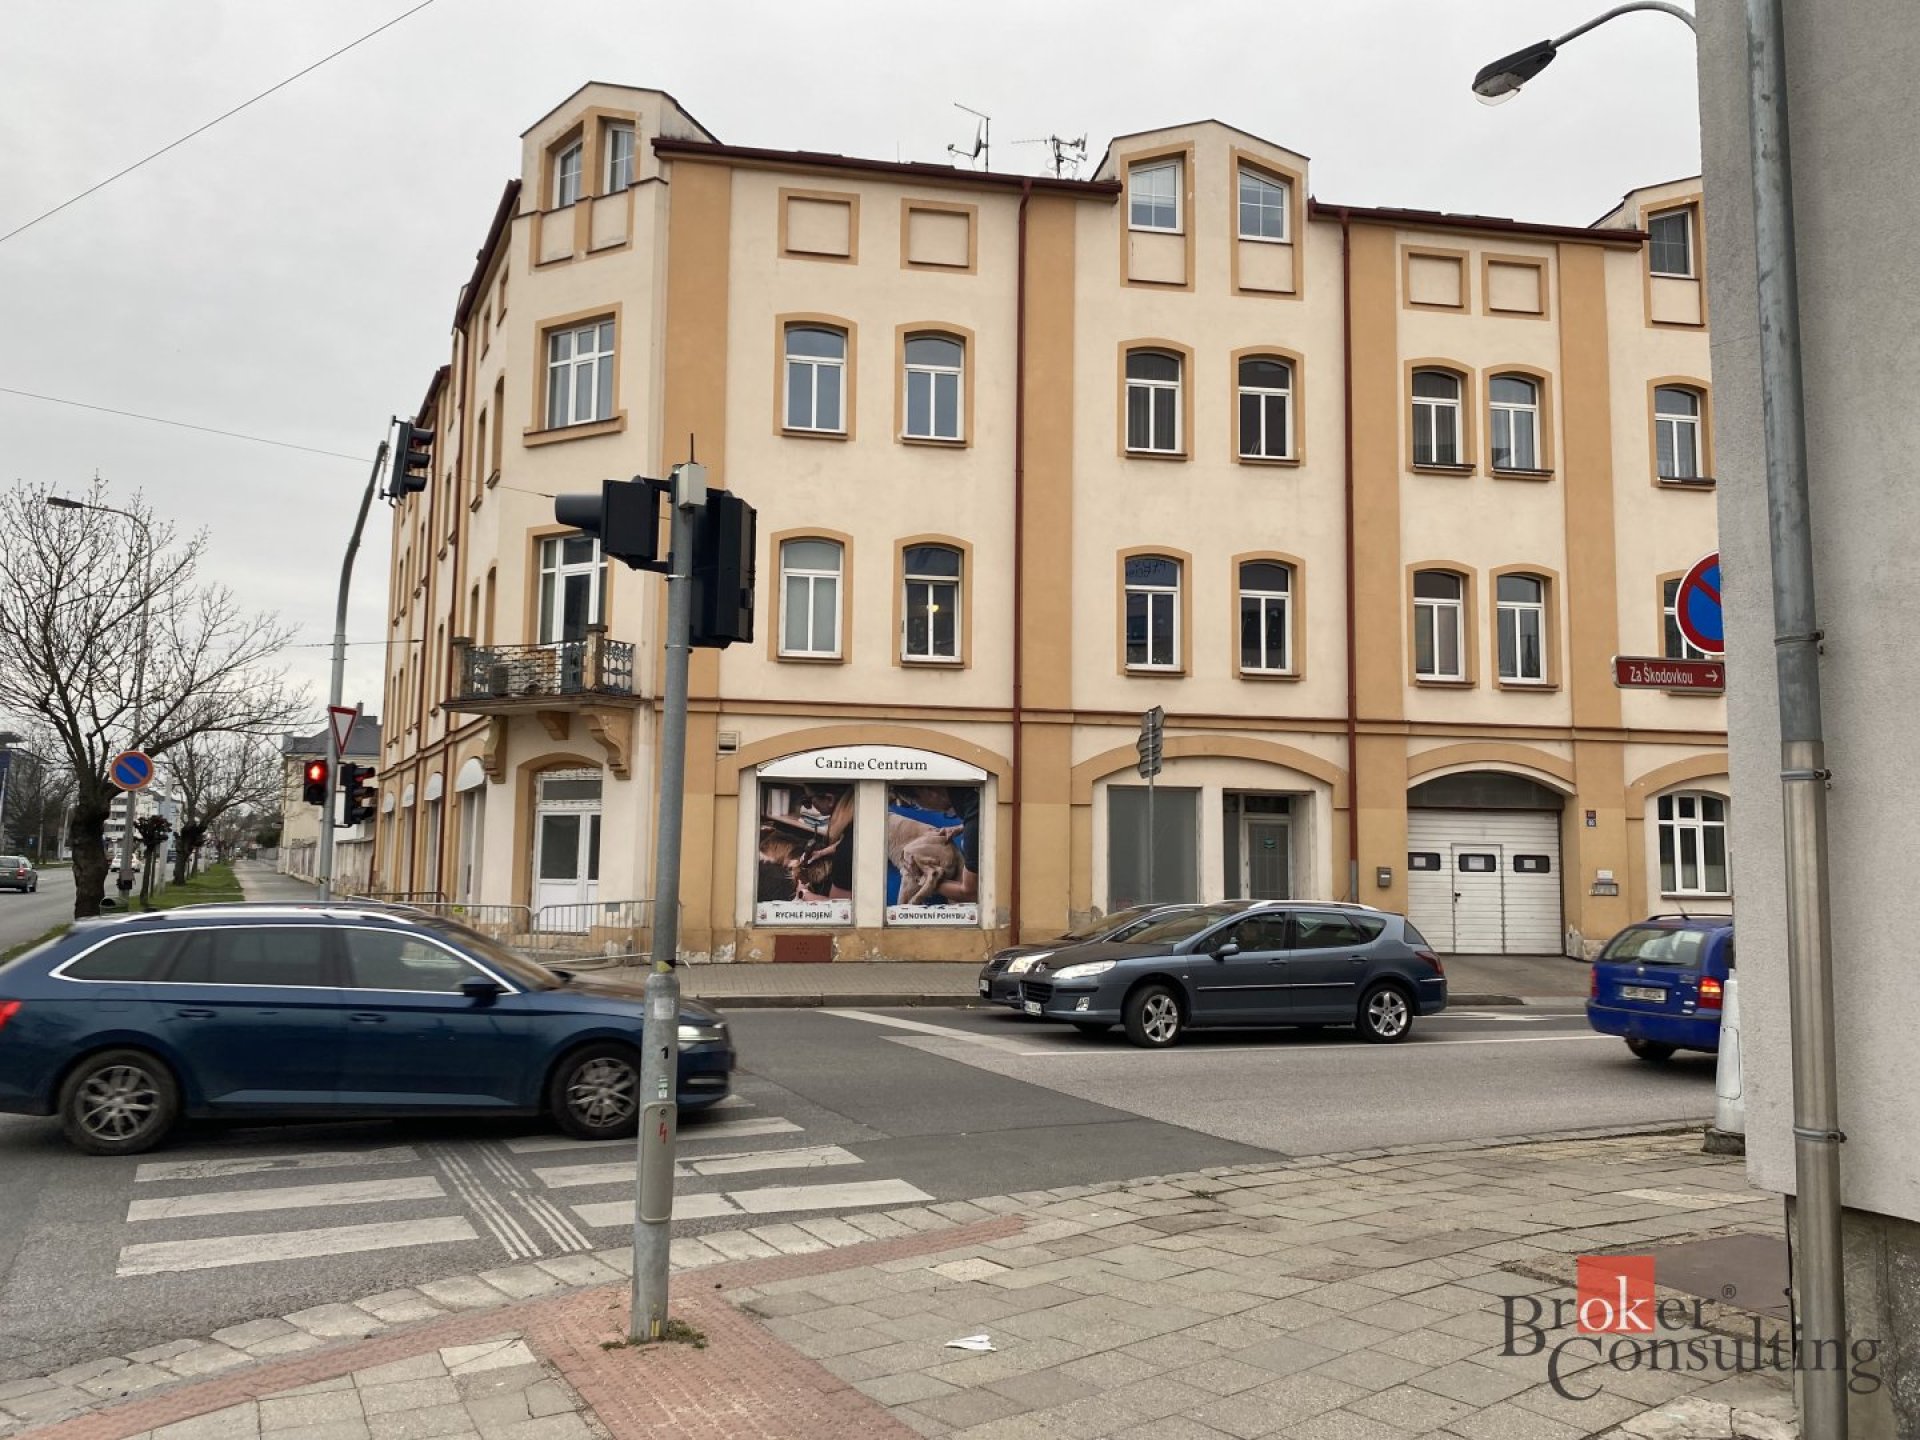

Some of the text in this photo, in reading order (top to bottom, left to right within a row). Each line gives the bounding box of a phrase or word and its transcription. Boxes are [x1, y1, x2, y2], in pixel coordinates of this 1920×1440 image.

[1629, 663, 1693, 685] Za Škodovkou
[815, 756, 928, 771] Canine Centrum
[805, 910, 832, 920] HOJENÍ
[898, 911, 966, 920] OBNOVENÍ POHYBU
[660, 1046, 669, 1060] 1
